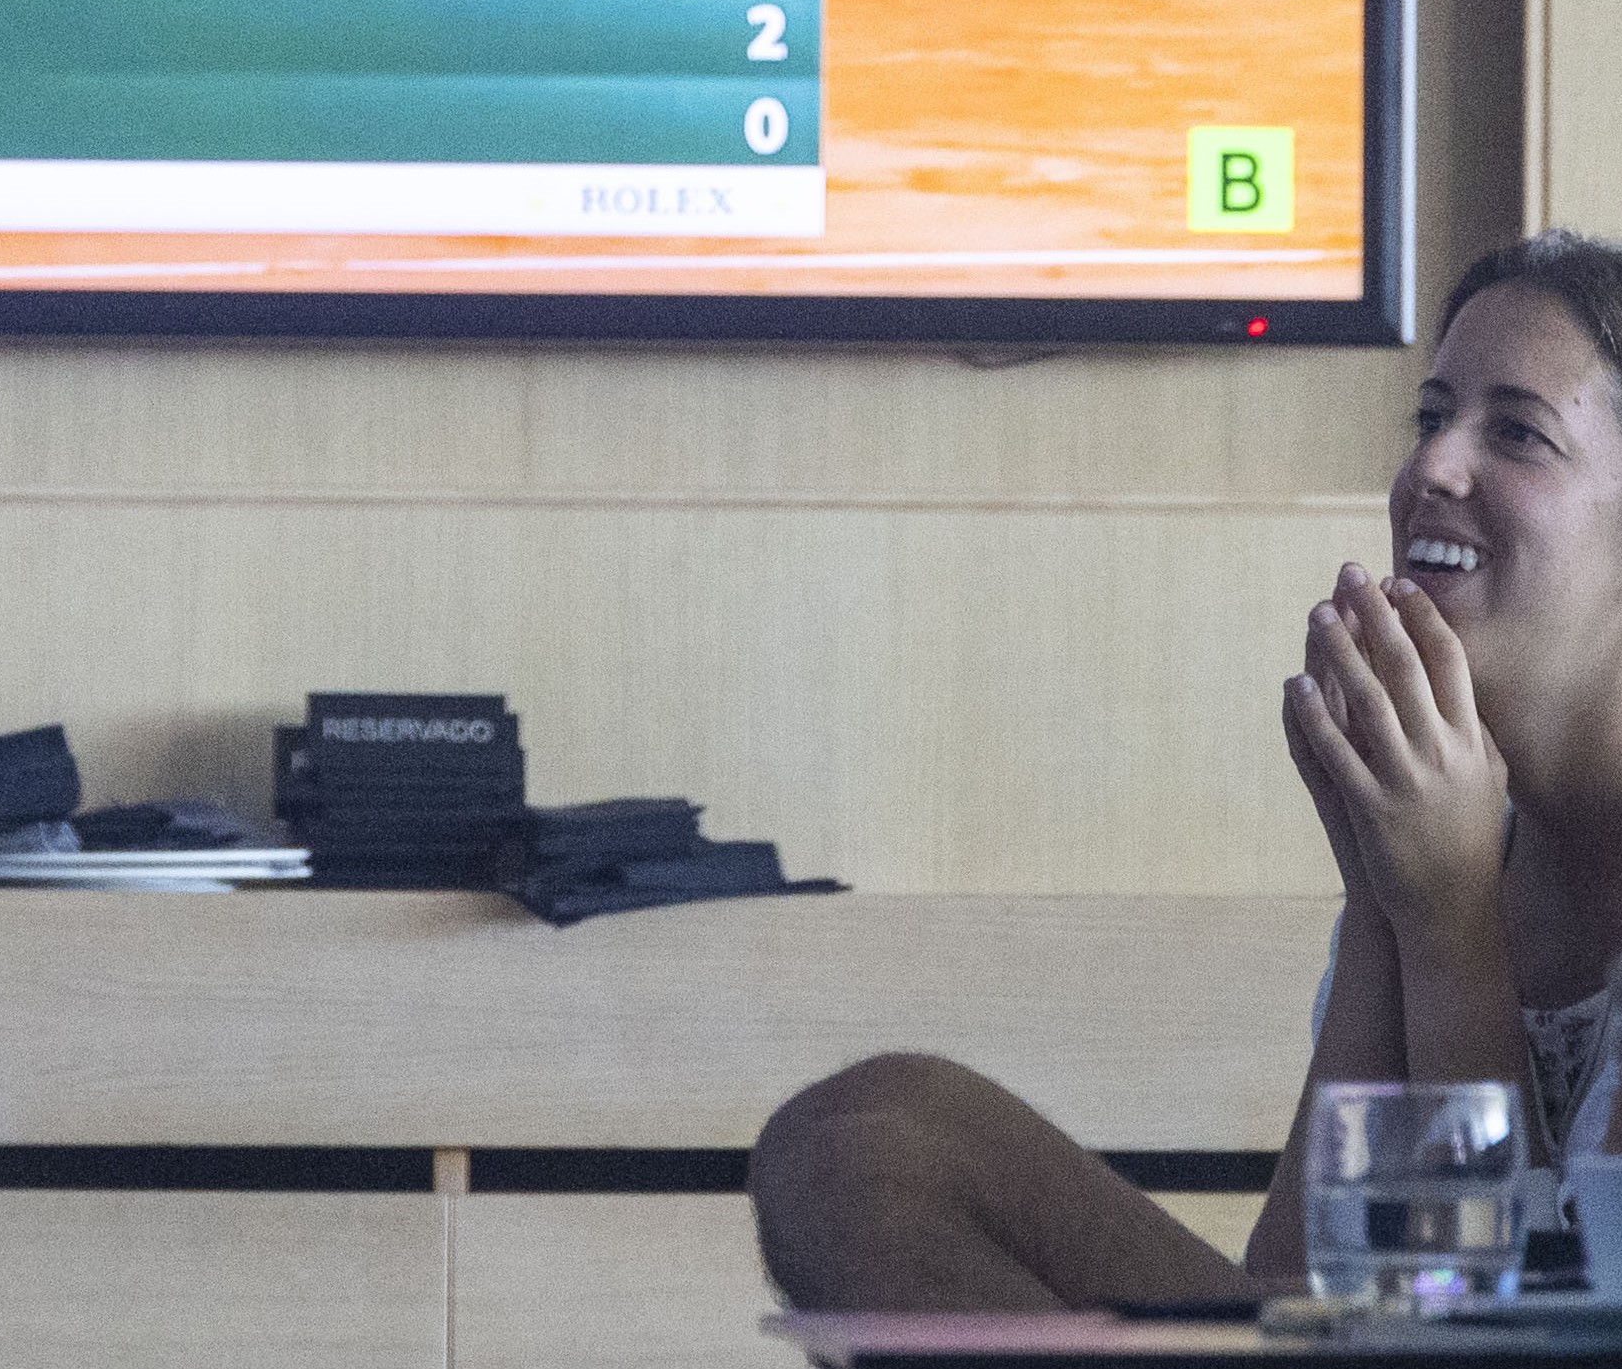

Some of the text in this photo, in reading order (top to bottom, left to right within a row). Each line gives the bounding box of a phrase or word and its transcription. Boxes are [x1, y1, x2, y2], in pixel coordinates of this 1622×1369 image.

[746, 3, 789, 62] 2
[743, 96, 789, 155] 0
[581, 185, 735, 216] ROLEX
[1219, 152, 1262, 213] B
[320, 717, 495, 744] RESERVADO
